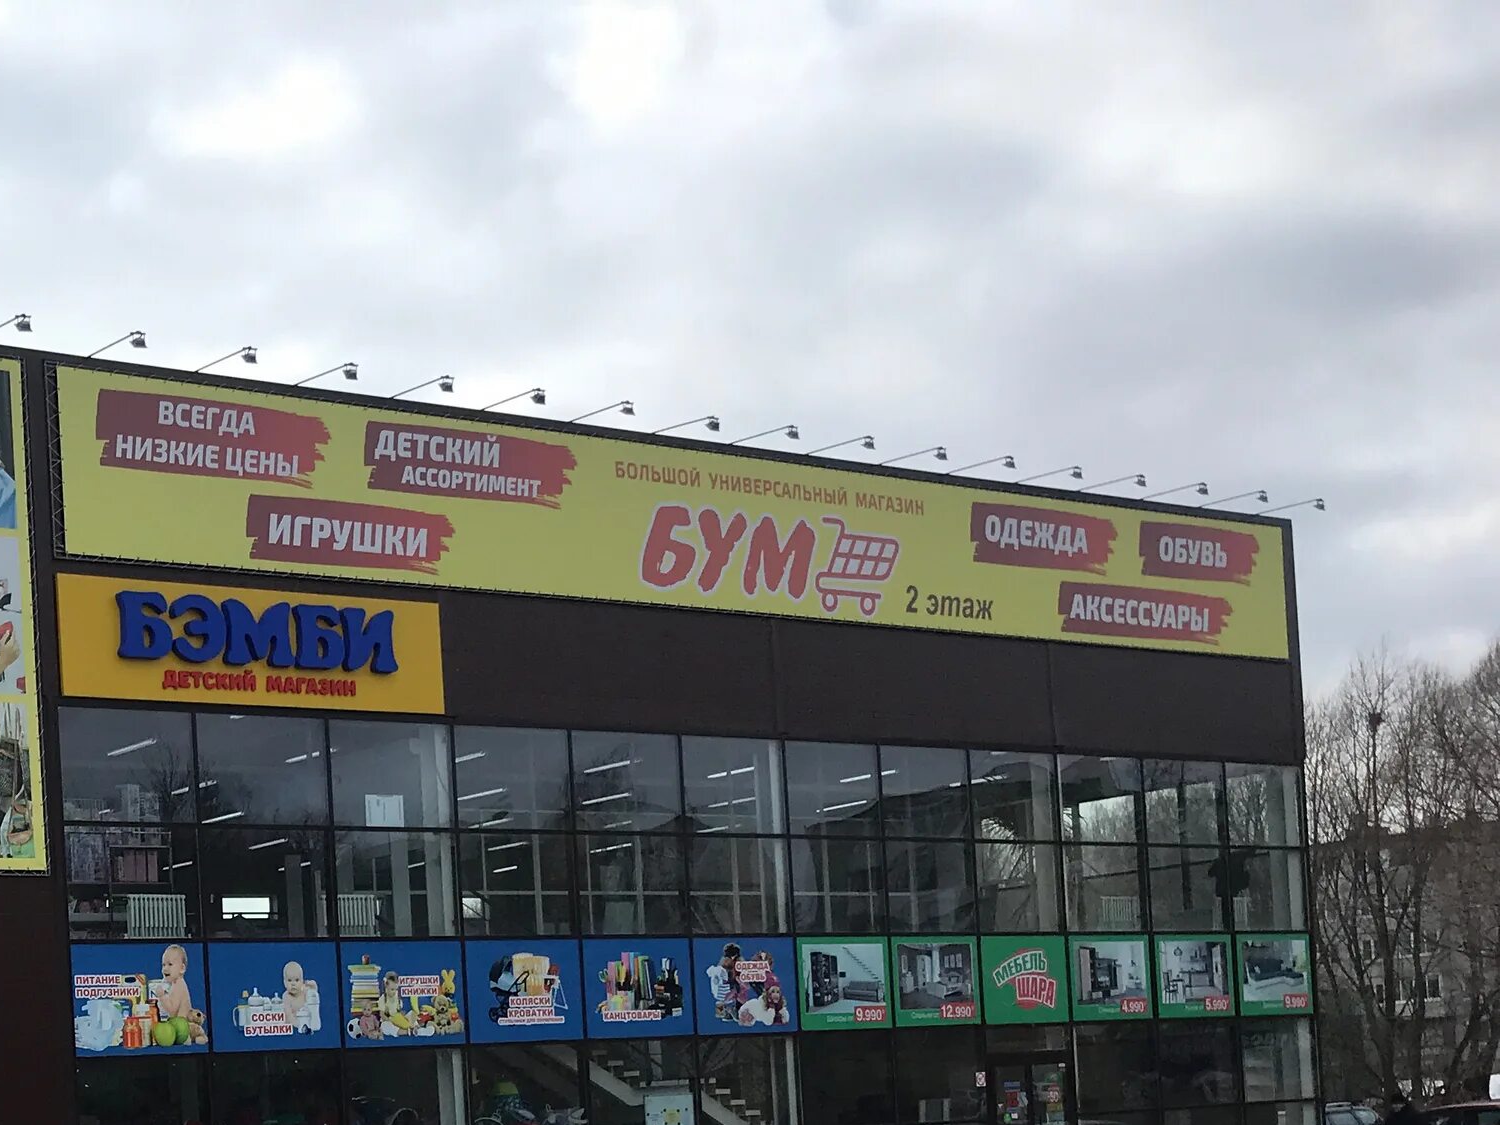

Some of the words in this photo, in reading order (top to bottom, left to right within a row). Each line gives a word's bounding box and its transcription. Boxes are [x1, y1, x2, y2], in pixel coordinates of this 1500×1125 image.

[157, 401, 256, 437] ВСЕГДА
[115, 434, 220, 470] НИЗКИЕ
[225, 448, 299, 478] ЦЕНЫ
[374, 430, 501, 468] ДЕТСКИЙ
[401, 466, 542, 499] АССОРТИМЕНТ
[615, 460, 701, 488] БОЛЬШОЙ
[708, 472, 848, 507] УНИВЕРСАЛЬНЫЙ
[855, 492, 925, 516] МАГАЗИН
[268, 512, 428, 559] ИГРУШКИ
[985, 514, 1088, 557] ОДЕЖДА
[641, 504, 817, 600] БУМ
[1158, 535, 1228, 569] ОБУВЬ
[905, 584, 919, 613] 2
[925, 593, 994, 620] этаж
[1070, 593, 1210, 633] АКСЕССУАРЫ
[115, 589, 399, 675] БЭМБИ
[162, 669, 257, 692] ДЕТСКИЙ
[266, 675, 357, 697] МАГАЗИН
[75, 975, 121, 985] ПИТАНИЕ
[399, 976, 440, 986] ИГРУШКИ
[735, 961, 769, 972] ОДЕЖДА
[740, 973, 766, 982] ОБУВЬ
[994, 951, 1048, 987] МЕБЕЛЬ
[76, 988, 139, 998] ПОДГУЗНИКИ
[400, 987, 438, 996] КНИЖКИ
[510, 997, 551, 1006] КОЛЯСКИ
[1016, 976, 1057, 1008] ШАРА
[251, 1012, 285, 1022] СОСКИ
[508, 1008, 554, 1018] КРОВАТКИ
[603, 1011, 661, 1021] КАНЦТОВАРЫ
[244, 1025, 293, 1035] БУТЫЛКИ
